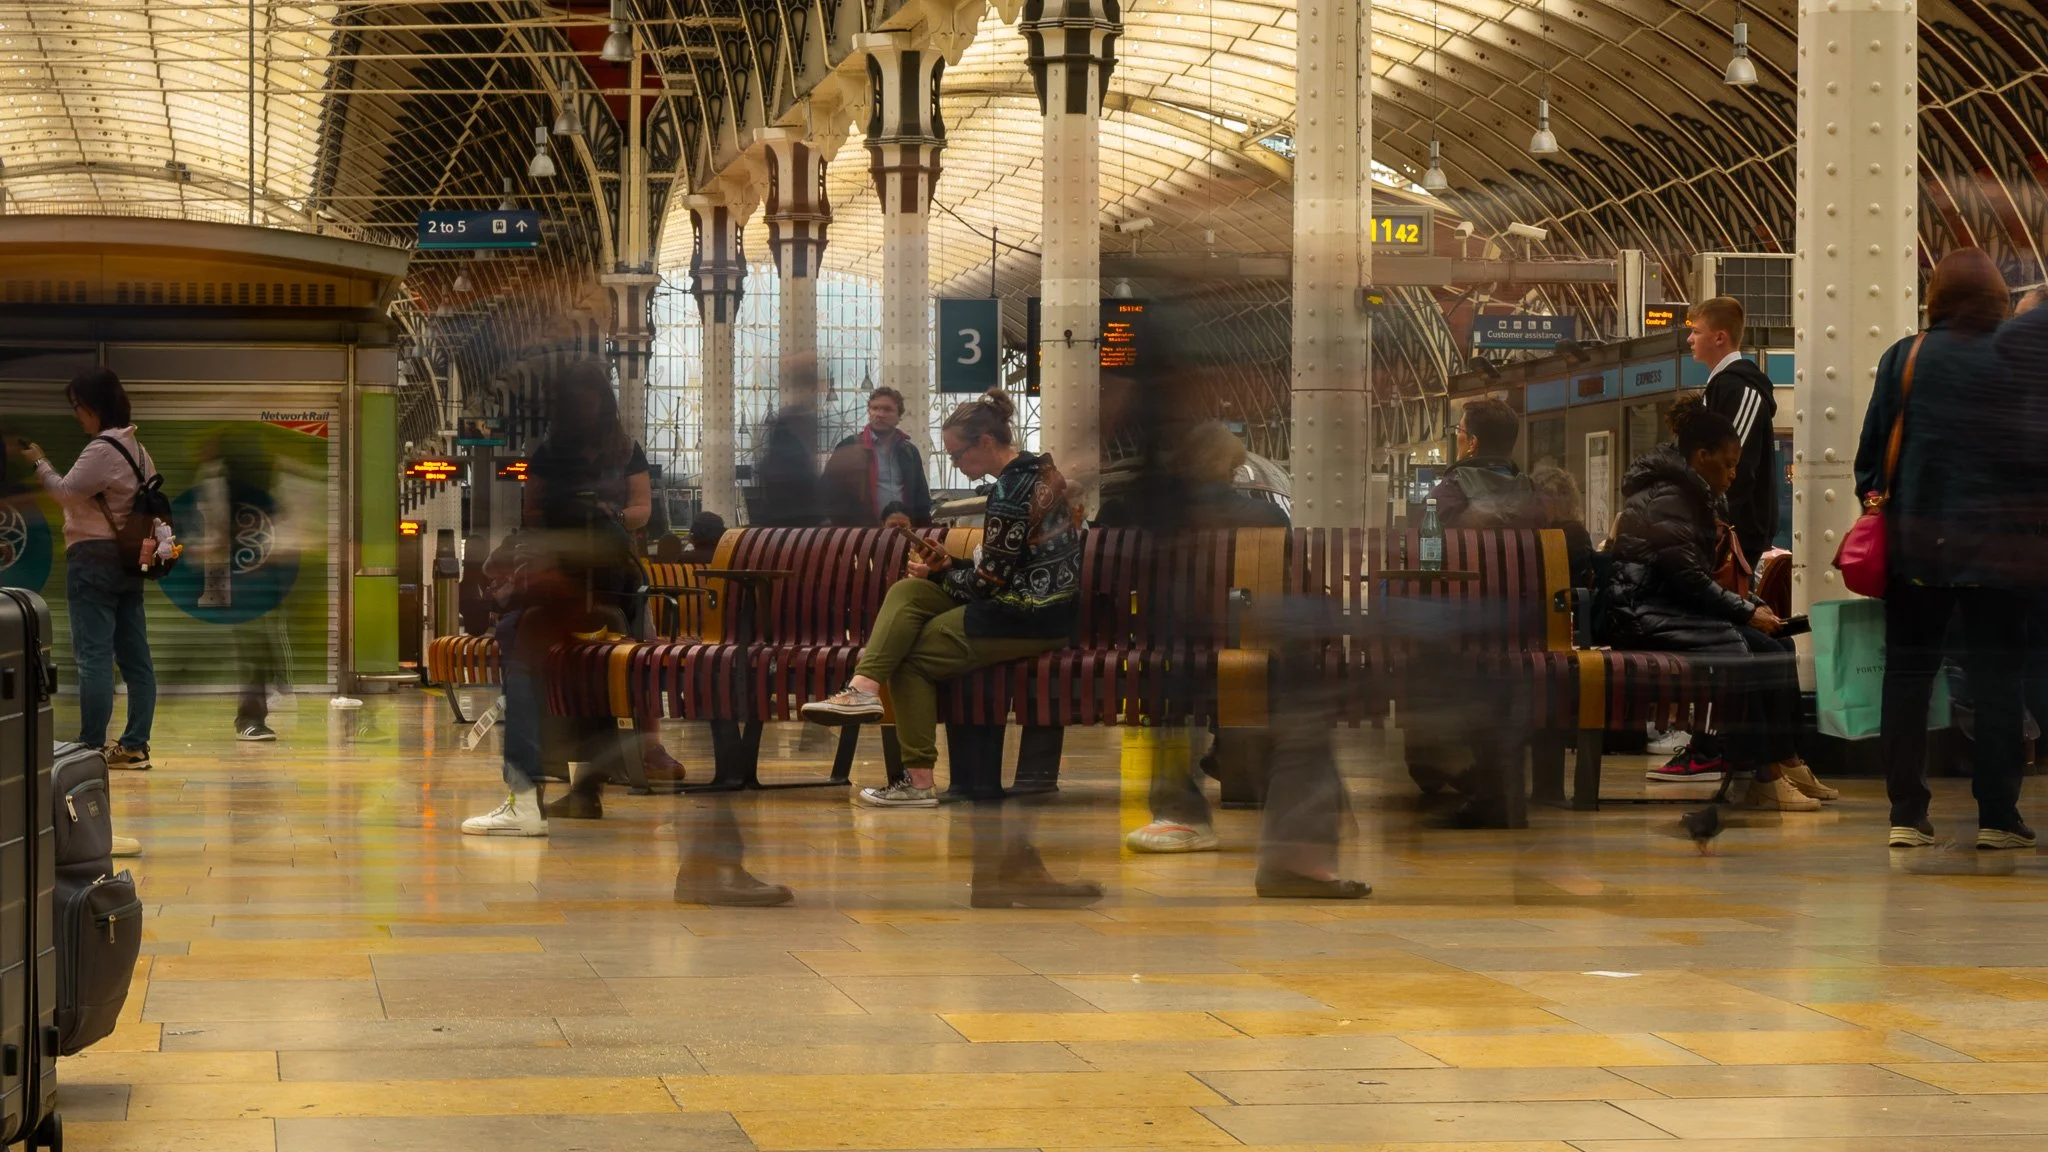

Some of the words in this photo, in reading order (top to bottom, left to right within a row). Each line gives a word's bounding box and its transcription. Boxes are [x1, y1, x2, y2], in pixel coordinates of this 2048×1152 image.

[428, 221, 437, 233] 2
[440, 222, 454, 233] to
[457, 221, 466, 233] 5
[1487, 330, 1523, 339] Customer
[1524, 331, 1562, 340] assistance
[957, 328, 982, 365] 3
[1635, 369, 1662, 387] EXPRESS
[261, 411, 330, 421] NetworkRail
[1856, 664, 1886, 675] FORTN
